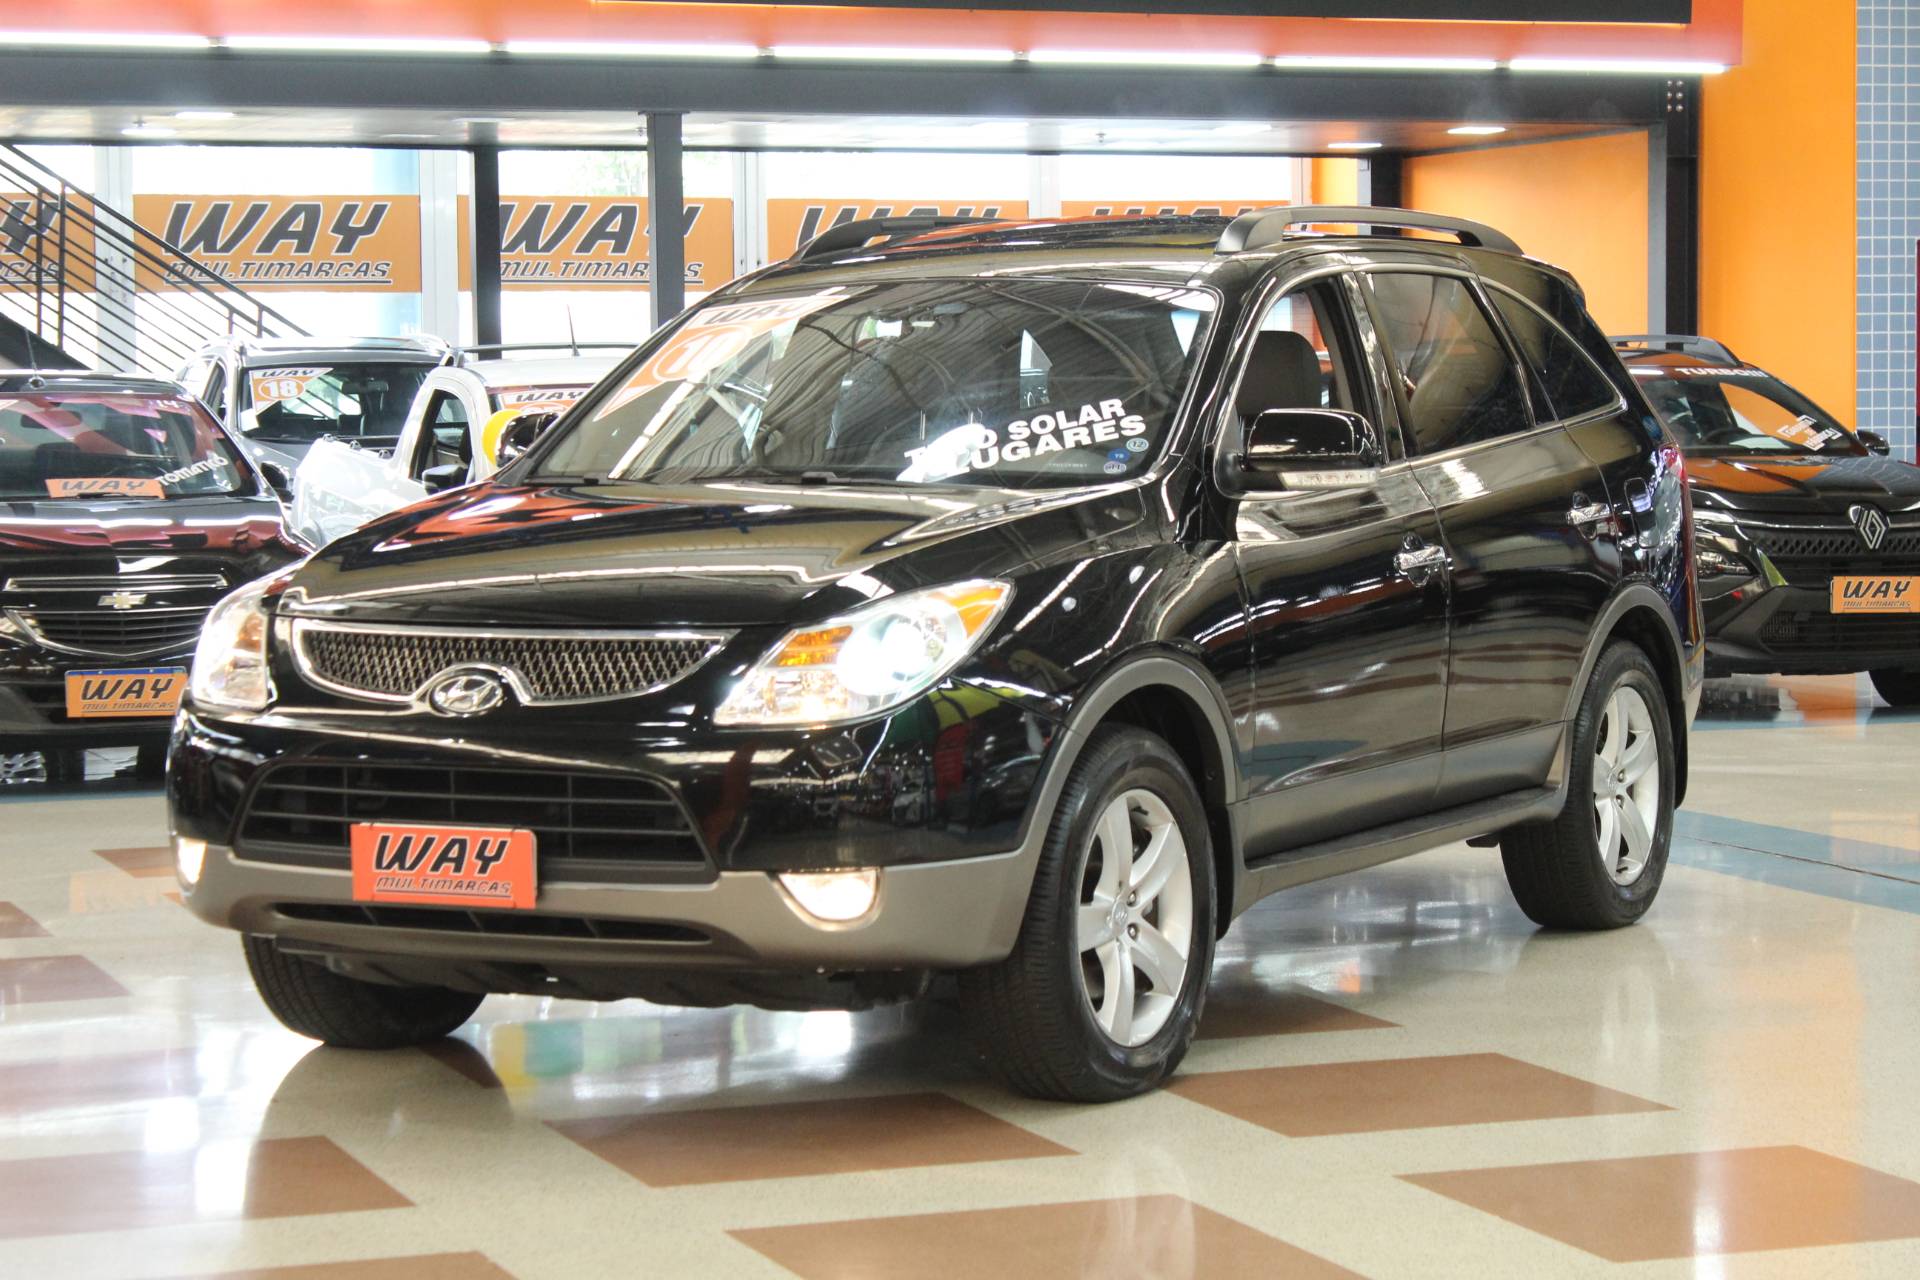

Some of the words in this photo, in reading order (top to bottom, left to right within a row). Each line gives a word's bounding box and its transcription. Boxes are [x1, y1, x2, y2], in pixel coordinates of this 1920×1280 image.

[163, 202, 391, 255] WAY
[500, 260, 703, 278] MULTIMARS
[264, 381, 298, 397] 18
[516, 391, 584, 402] WAY
[1008, 398, 1126, 441] SOLAR
[62, 480, 145, 490] WAY
[1843, 580, 1911, 598] WAY
[81, 678, 174, 700] WAY
[374, 833, 509, 875] WAY
